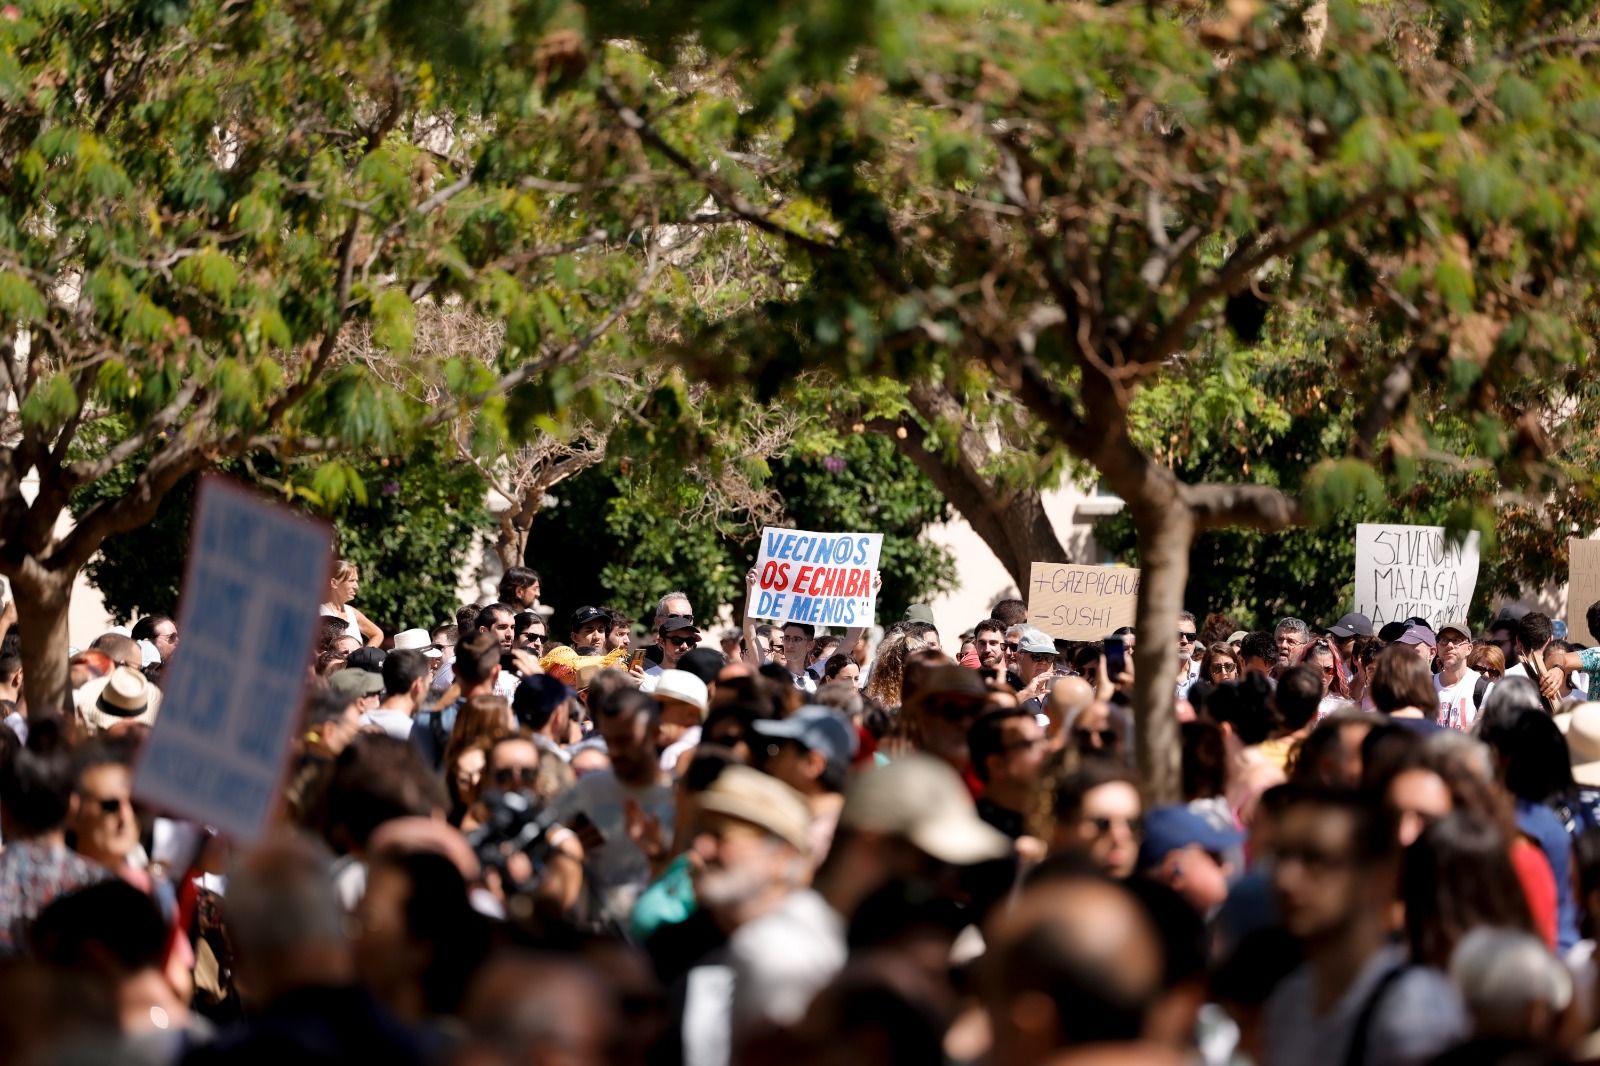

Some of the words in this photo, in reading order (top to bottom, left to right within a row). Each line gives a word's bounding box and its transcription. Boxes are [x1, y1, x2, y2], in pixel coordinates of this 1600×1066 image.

[759, 560, 791, 592] OS
[792, 565, 870, 598] ECHABA
[1374, 567, 1460, 604] MALAGA
[756, 591, 786, 618] DE
[788, 595, 856, 625] MENOS
